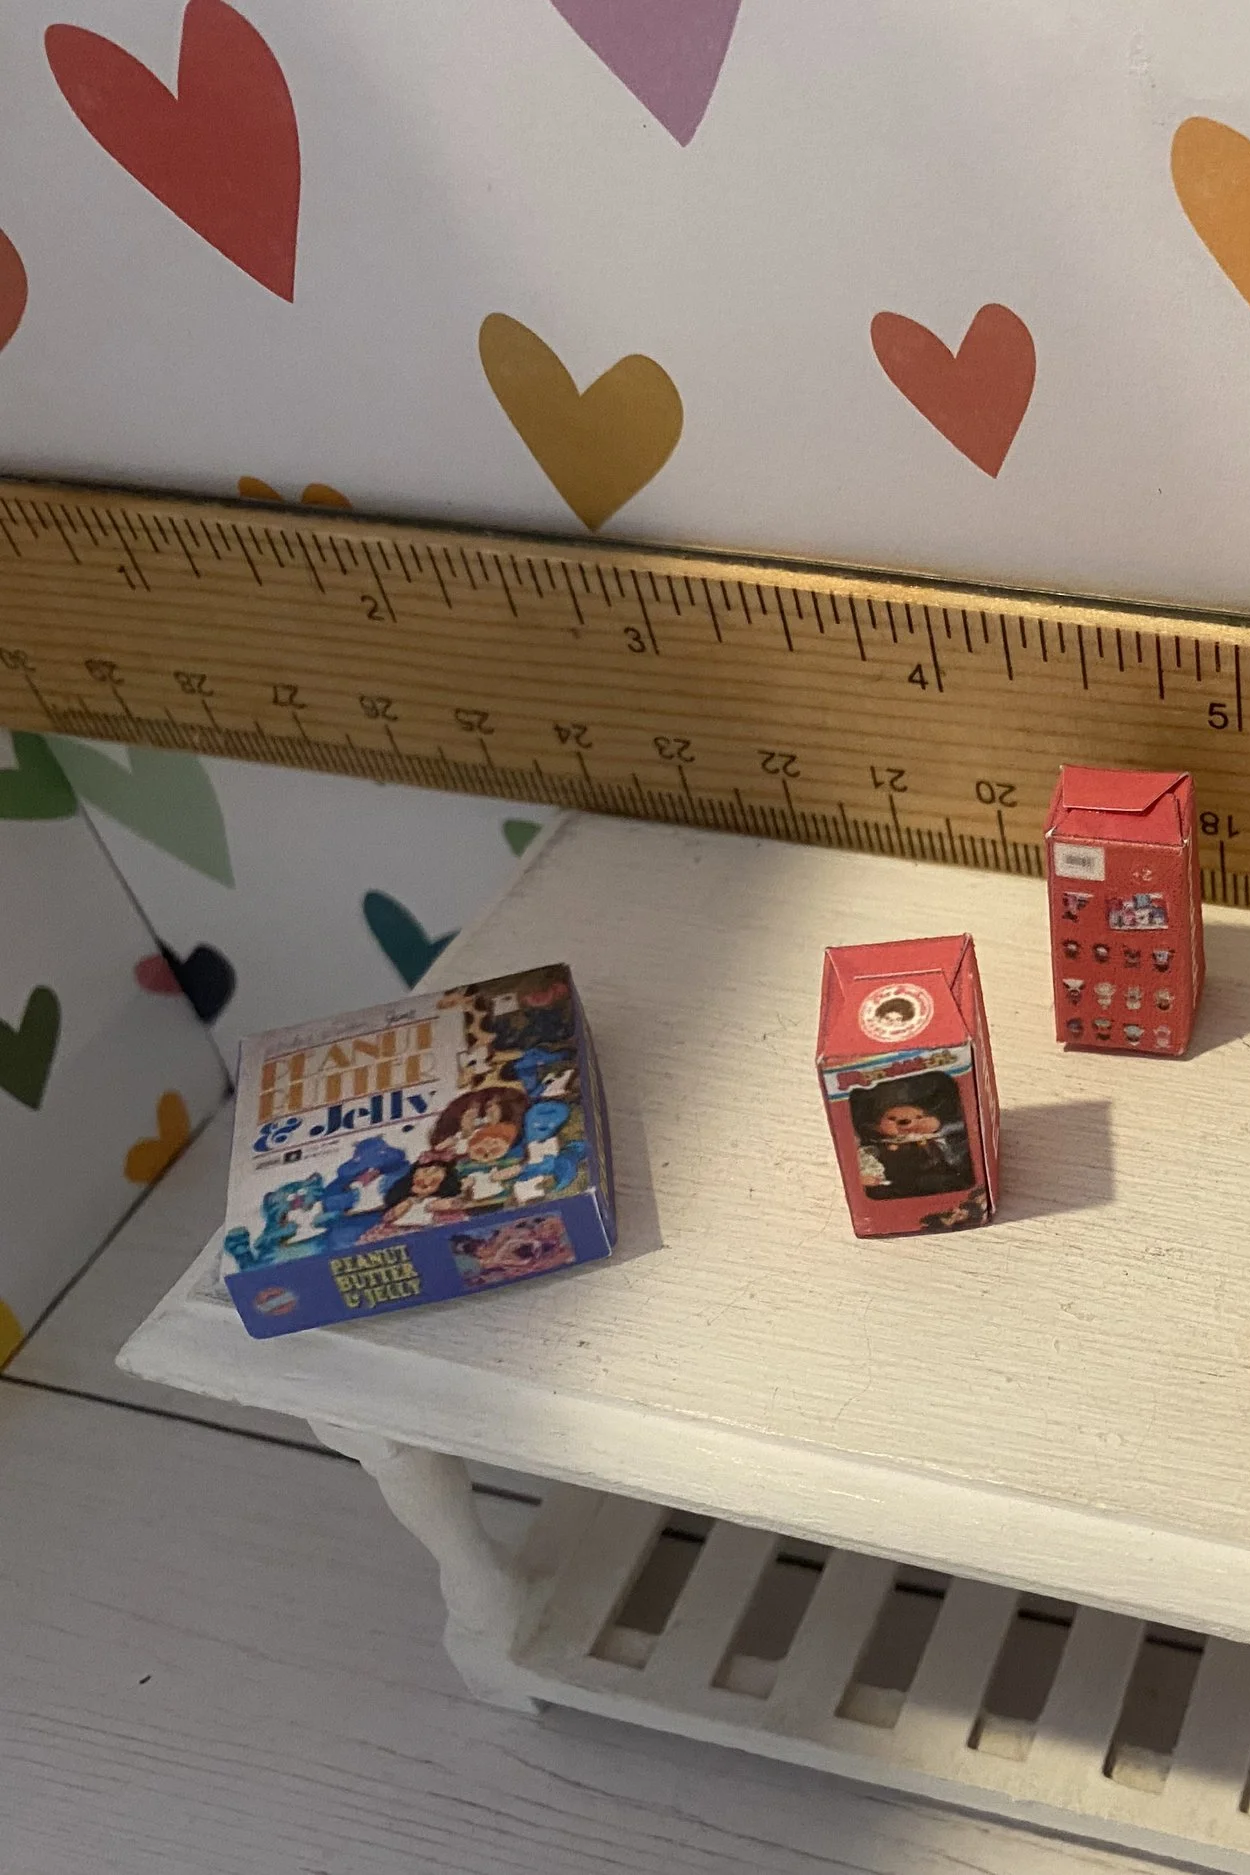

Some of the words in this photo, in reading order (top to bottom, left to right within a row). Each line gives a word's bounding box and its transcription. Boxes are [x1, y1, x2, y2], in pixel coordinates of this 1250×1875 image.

[118, 564, 136, 590] 1
[361, 595, 384, 620] 2
[624, 627, 646, 653] 3
[174, 672, 213, 697] 28
[908, 663, 929, 690] 4
[272, 684, 307, 709] 27
[359, 695, 398, 721] 26
[454, 708, 494, 735] 25
[1208, 703, 1229, 729] 5
[553, 722, 592, 749] 24
[653, 736, 695, 762] 23
[757, 750, 800, 778] 22
[870, 766, 908, 793] 21
[975, 781, 1017, 807] 20
[1200, 811, 1240, 838] 18
